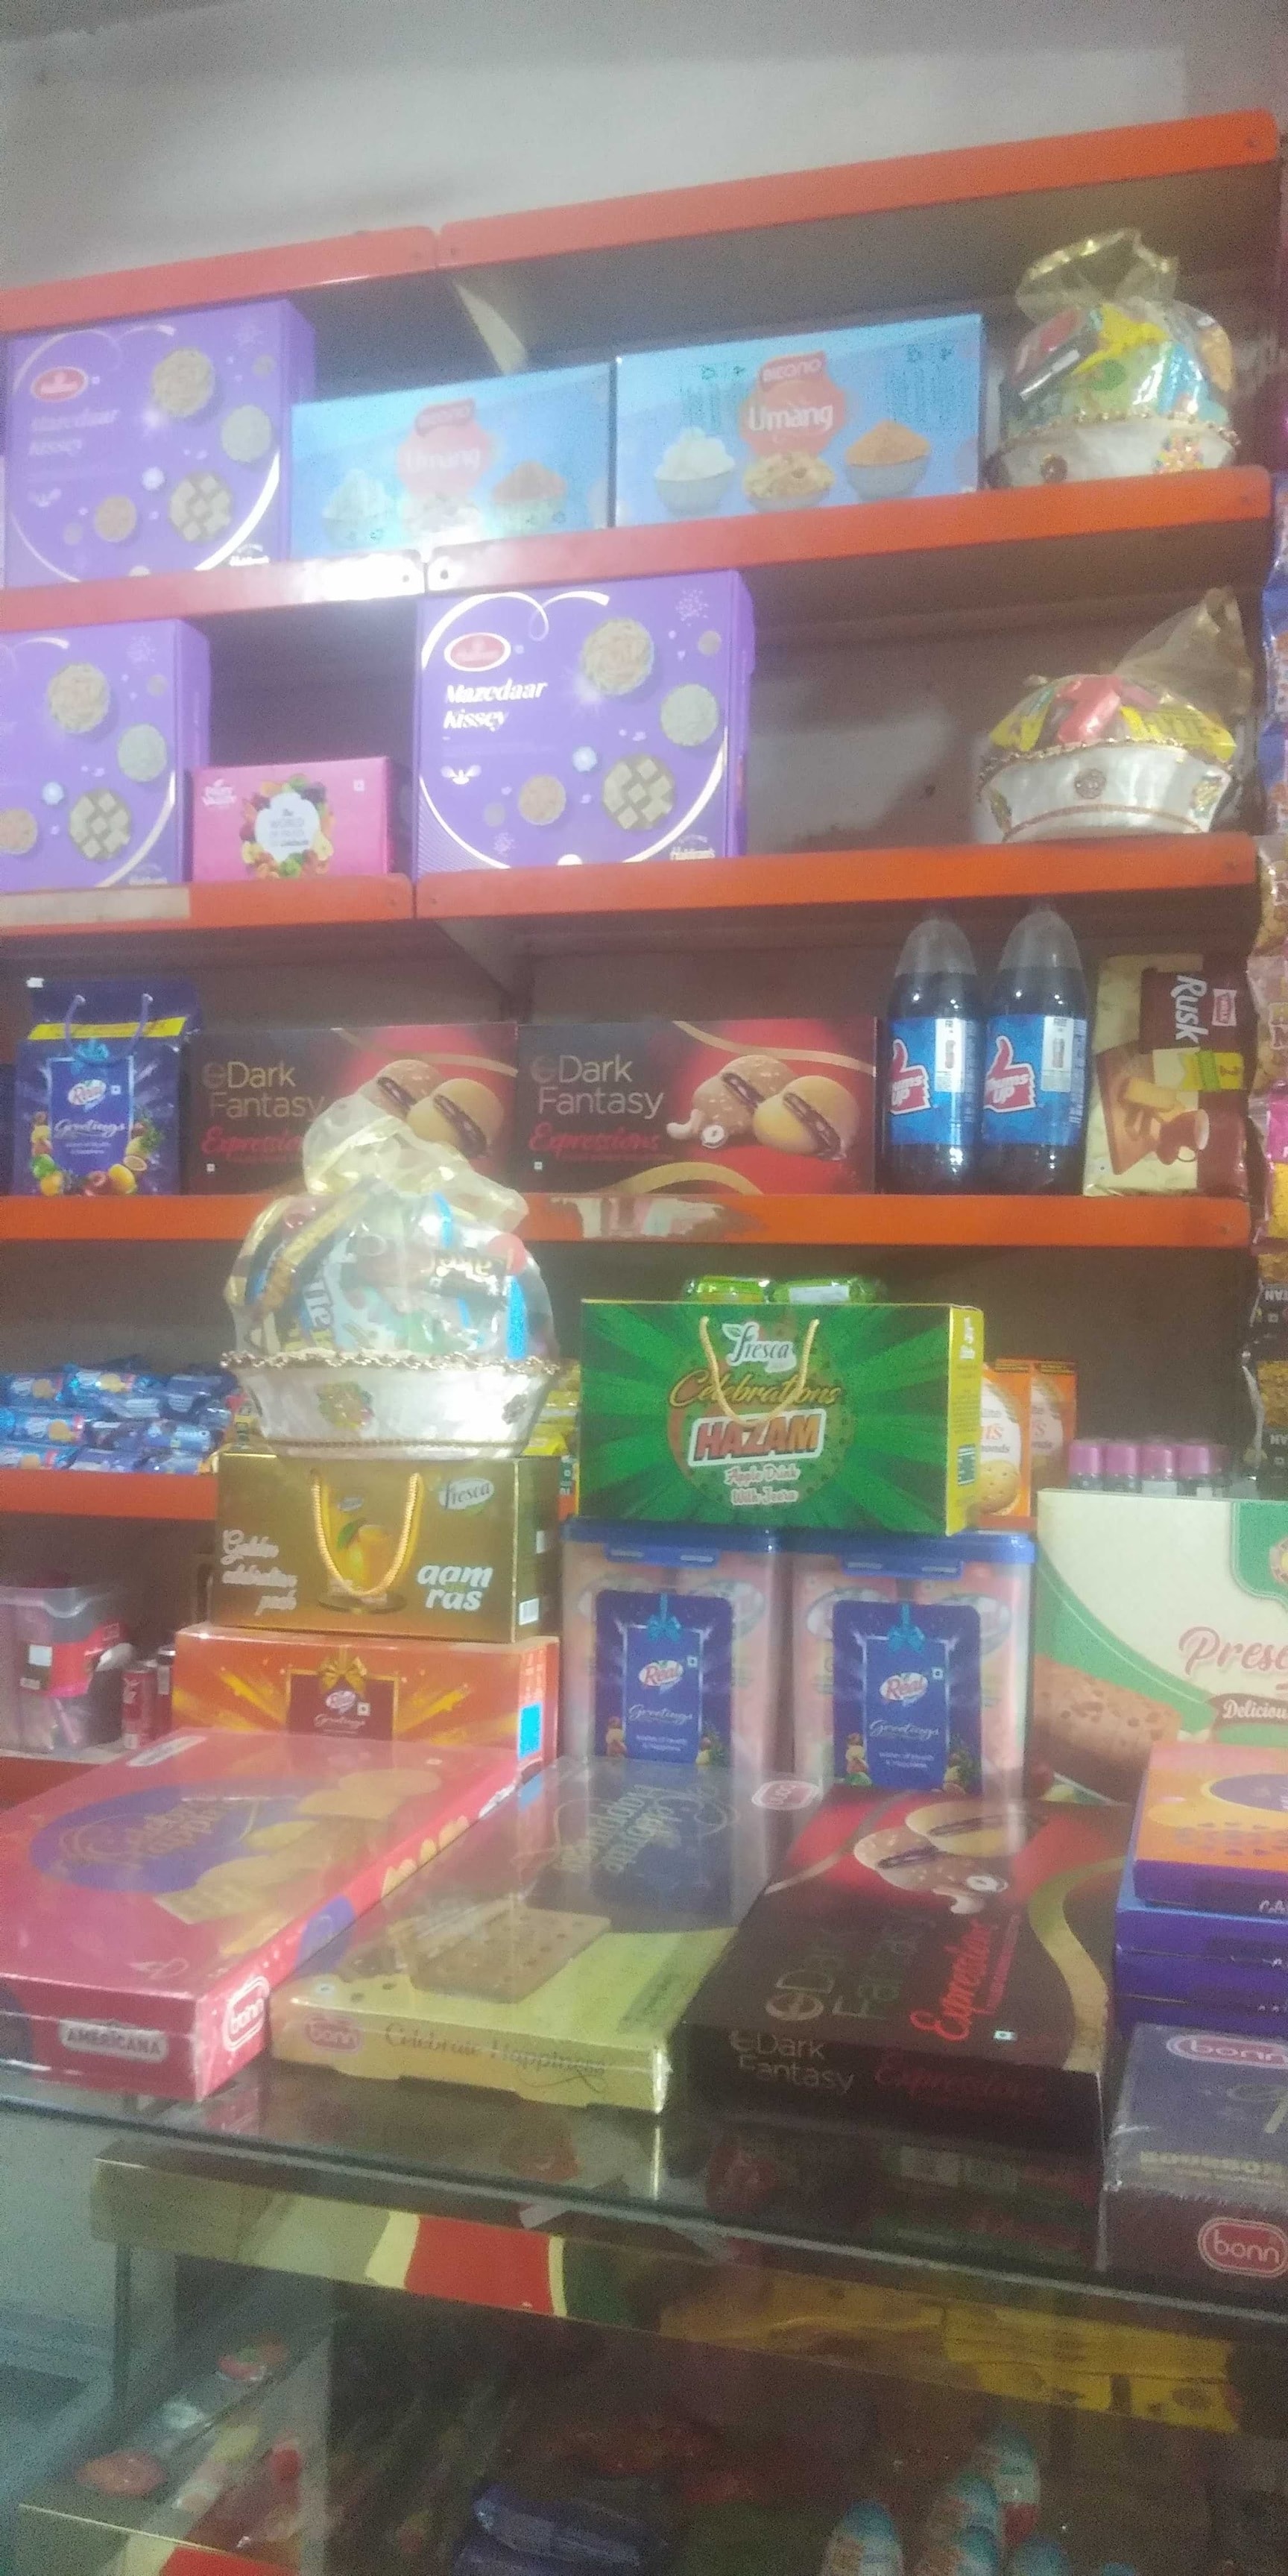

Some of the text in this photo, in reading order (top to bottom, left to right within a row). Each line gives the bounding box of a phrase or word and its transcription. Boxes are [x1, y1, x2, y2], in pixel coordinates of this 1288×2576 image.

[748, 404, 833, 432] Umang
[446, 678, 549, 703] Mazedaar
[1170, 975, 1209, 1044] Rusk
[227, 1061, 296, 1088] Dark
[562, 1054, 633, 1082] Dark
[539, 1086, 664, 1120] Fantasy
[731, 1323, 790, 1363] fresca
[670, 1368, 842, 1407] Celebratons
[693, 1412, 823, 1461] HAZAM
[443, 1478, 493, 1509] fresca
[417, 1565, 494, 1588] aam
[425, 1588, 483, 1612] ras
[1222, 1699, 1288, 1719] Deliciou
[230, 1998, 264, 2034] bonn
[66, 2027, 162, 2055] AMERICANA
[755, 2032, 824, 2060] Dark
[738, 2054, 856, 2095] Fantasy
[1212, 2228, 1281, 2264] bonn
